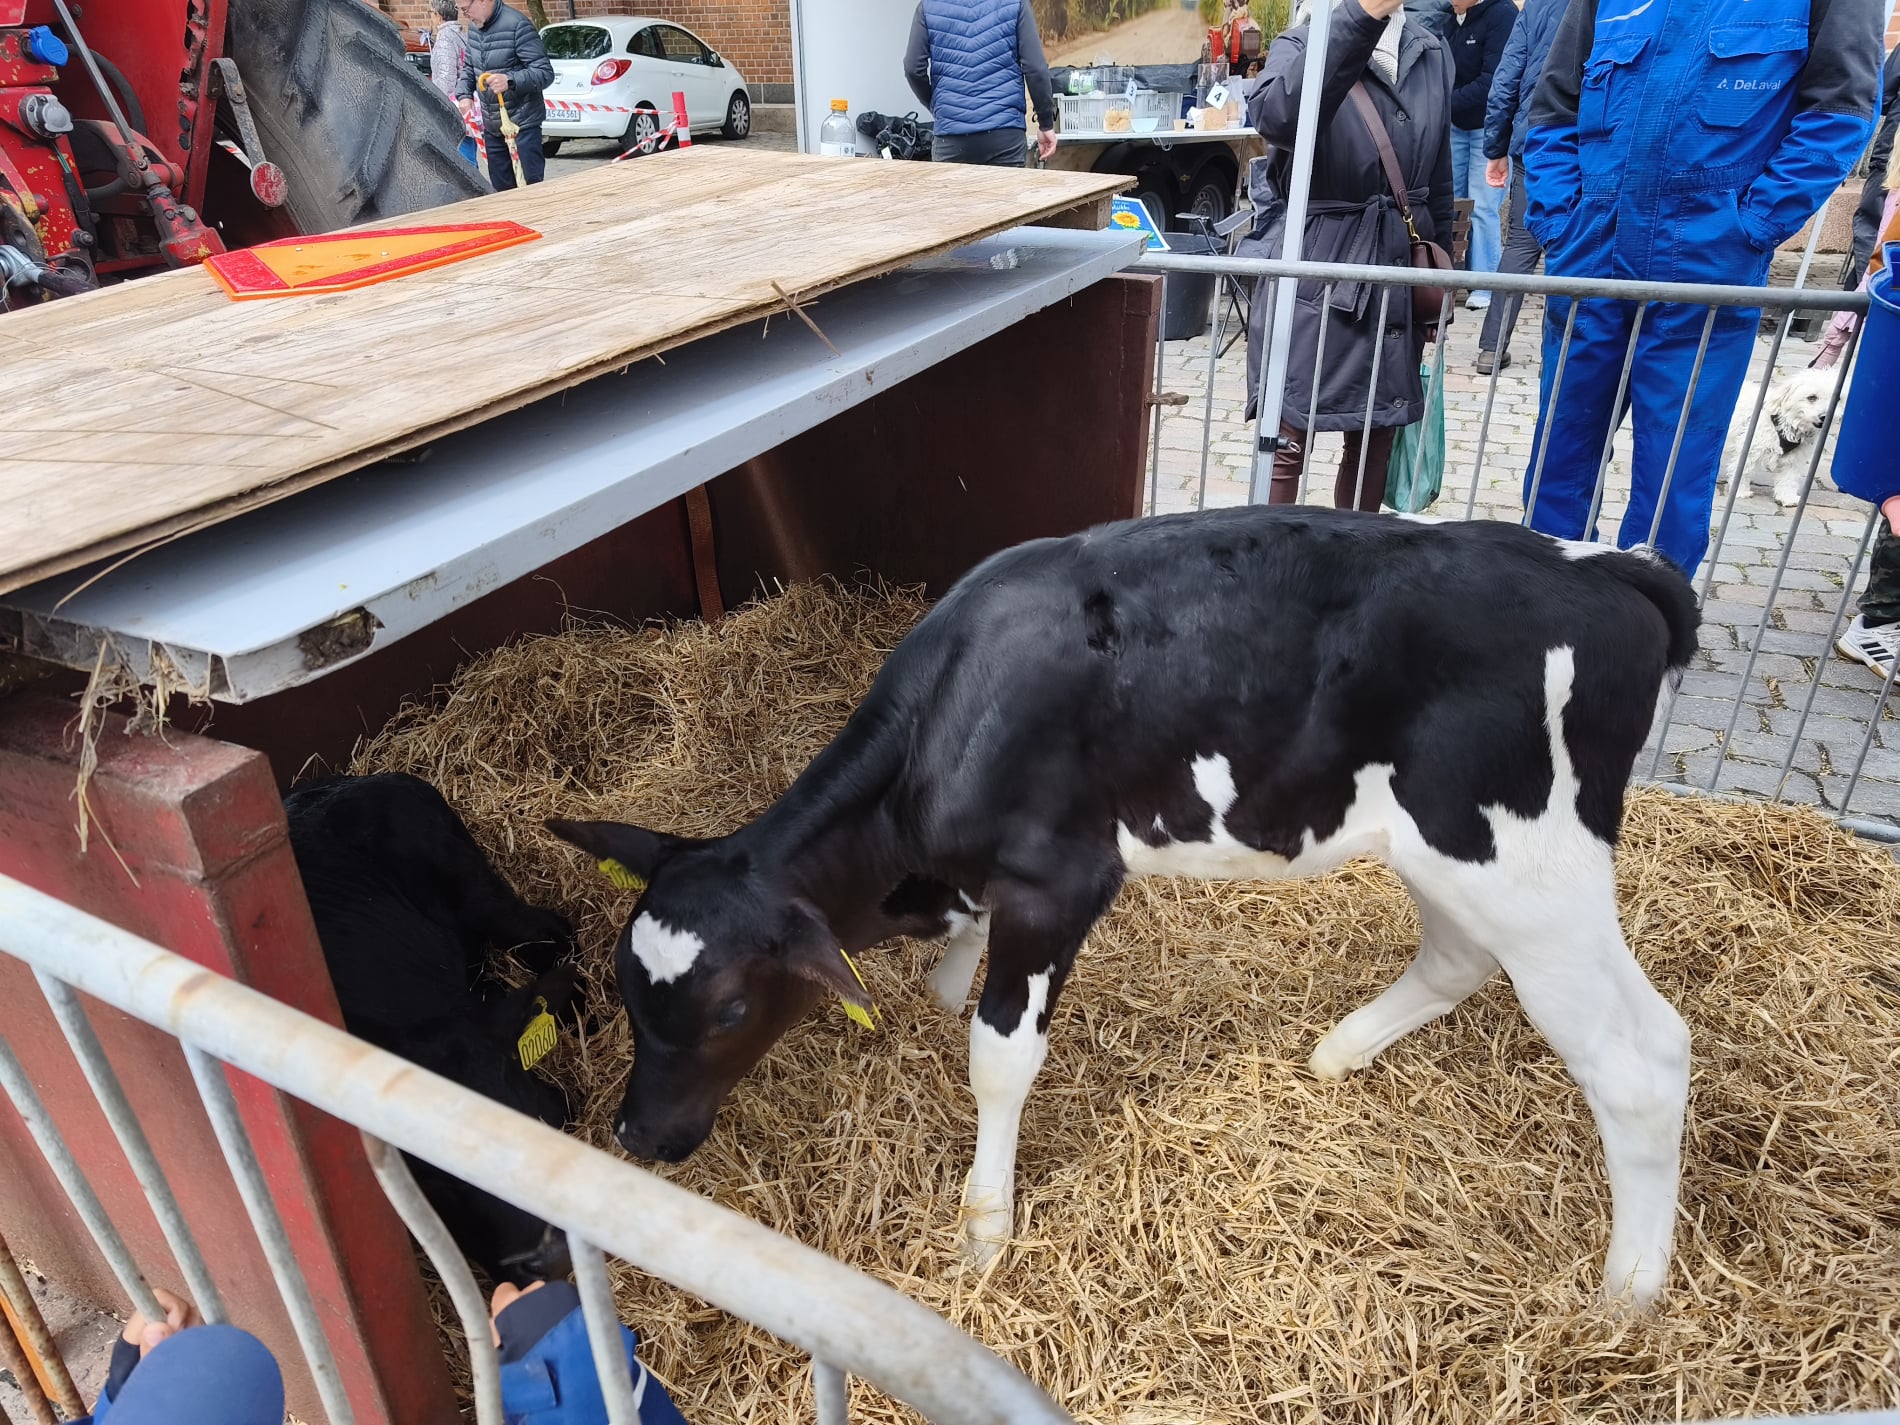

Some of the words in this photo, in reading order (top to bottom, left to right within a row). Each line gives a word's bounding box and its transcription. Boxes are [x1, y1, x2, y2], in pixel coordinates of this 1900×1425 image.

[1733, 79, 1781, 90] DeLaval
[1214, 92, 1223, 102] 4
[522, 1023, 555, 1069] 02060
